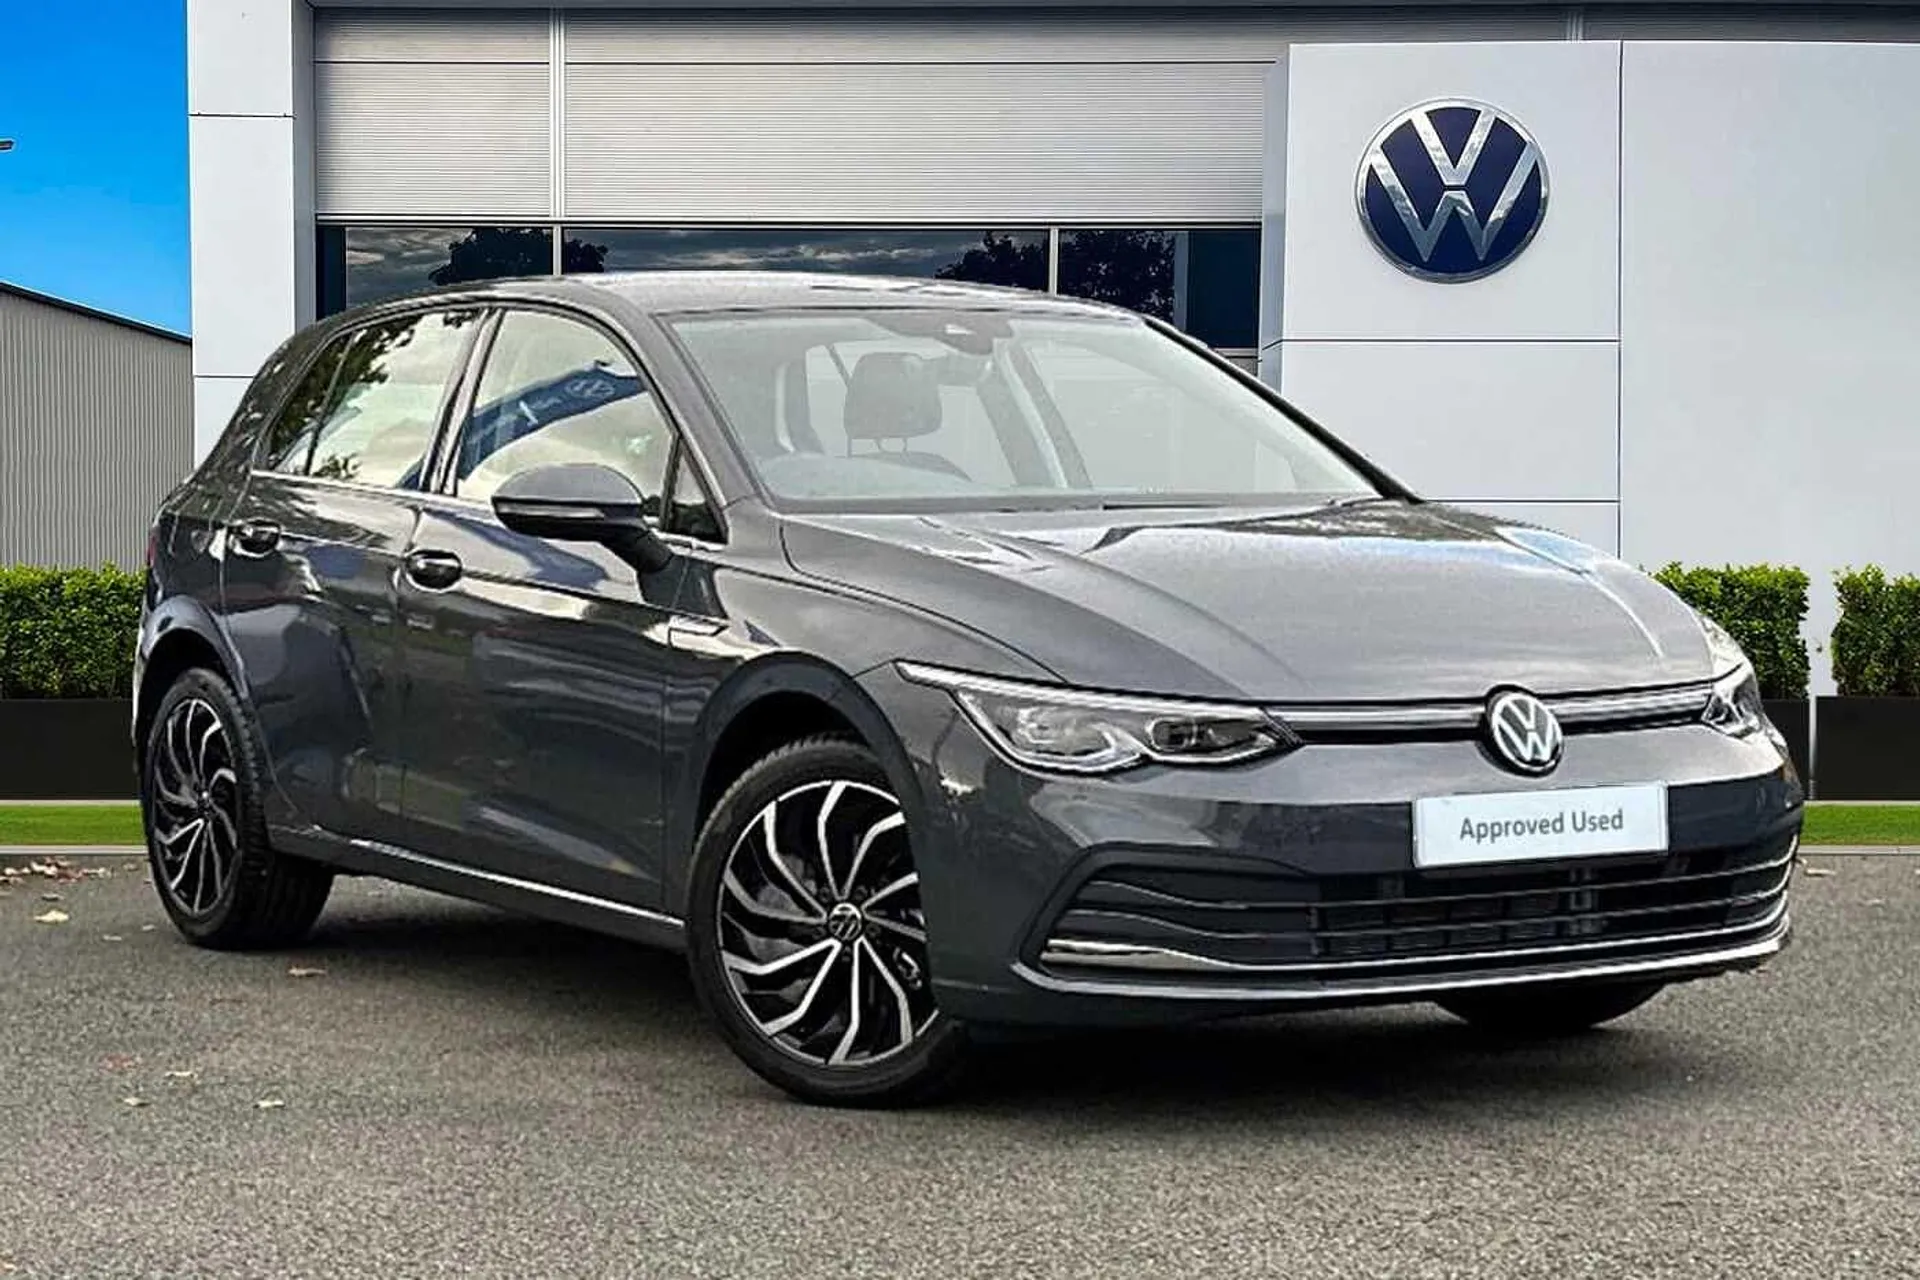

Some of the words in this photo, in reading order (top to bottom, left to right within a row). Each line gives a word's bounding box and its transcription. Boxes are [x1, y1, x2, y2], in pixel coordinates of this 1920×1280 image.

[1367, 106, 1540, 263] VW
[1495, 697, 1557, 761] VW
[1459, 810, 1565, 844] Approved
[1571, 808, 1624, 833] Used
